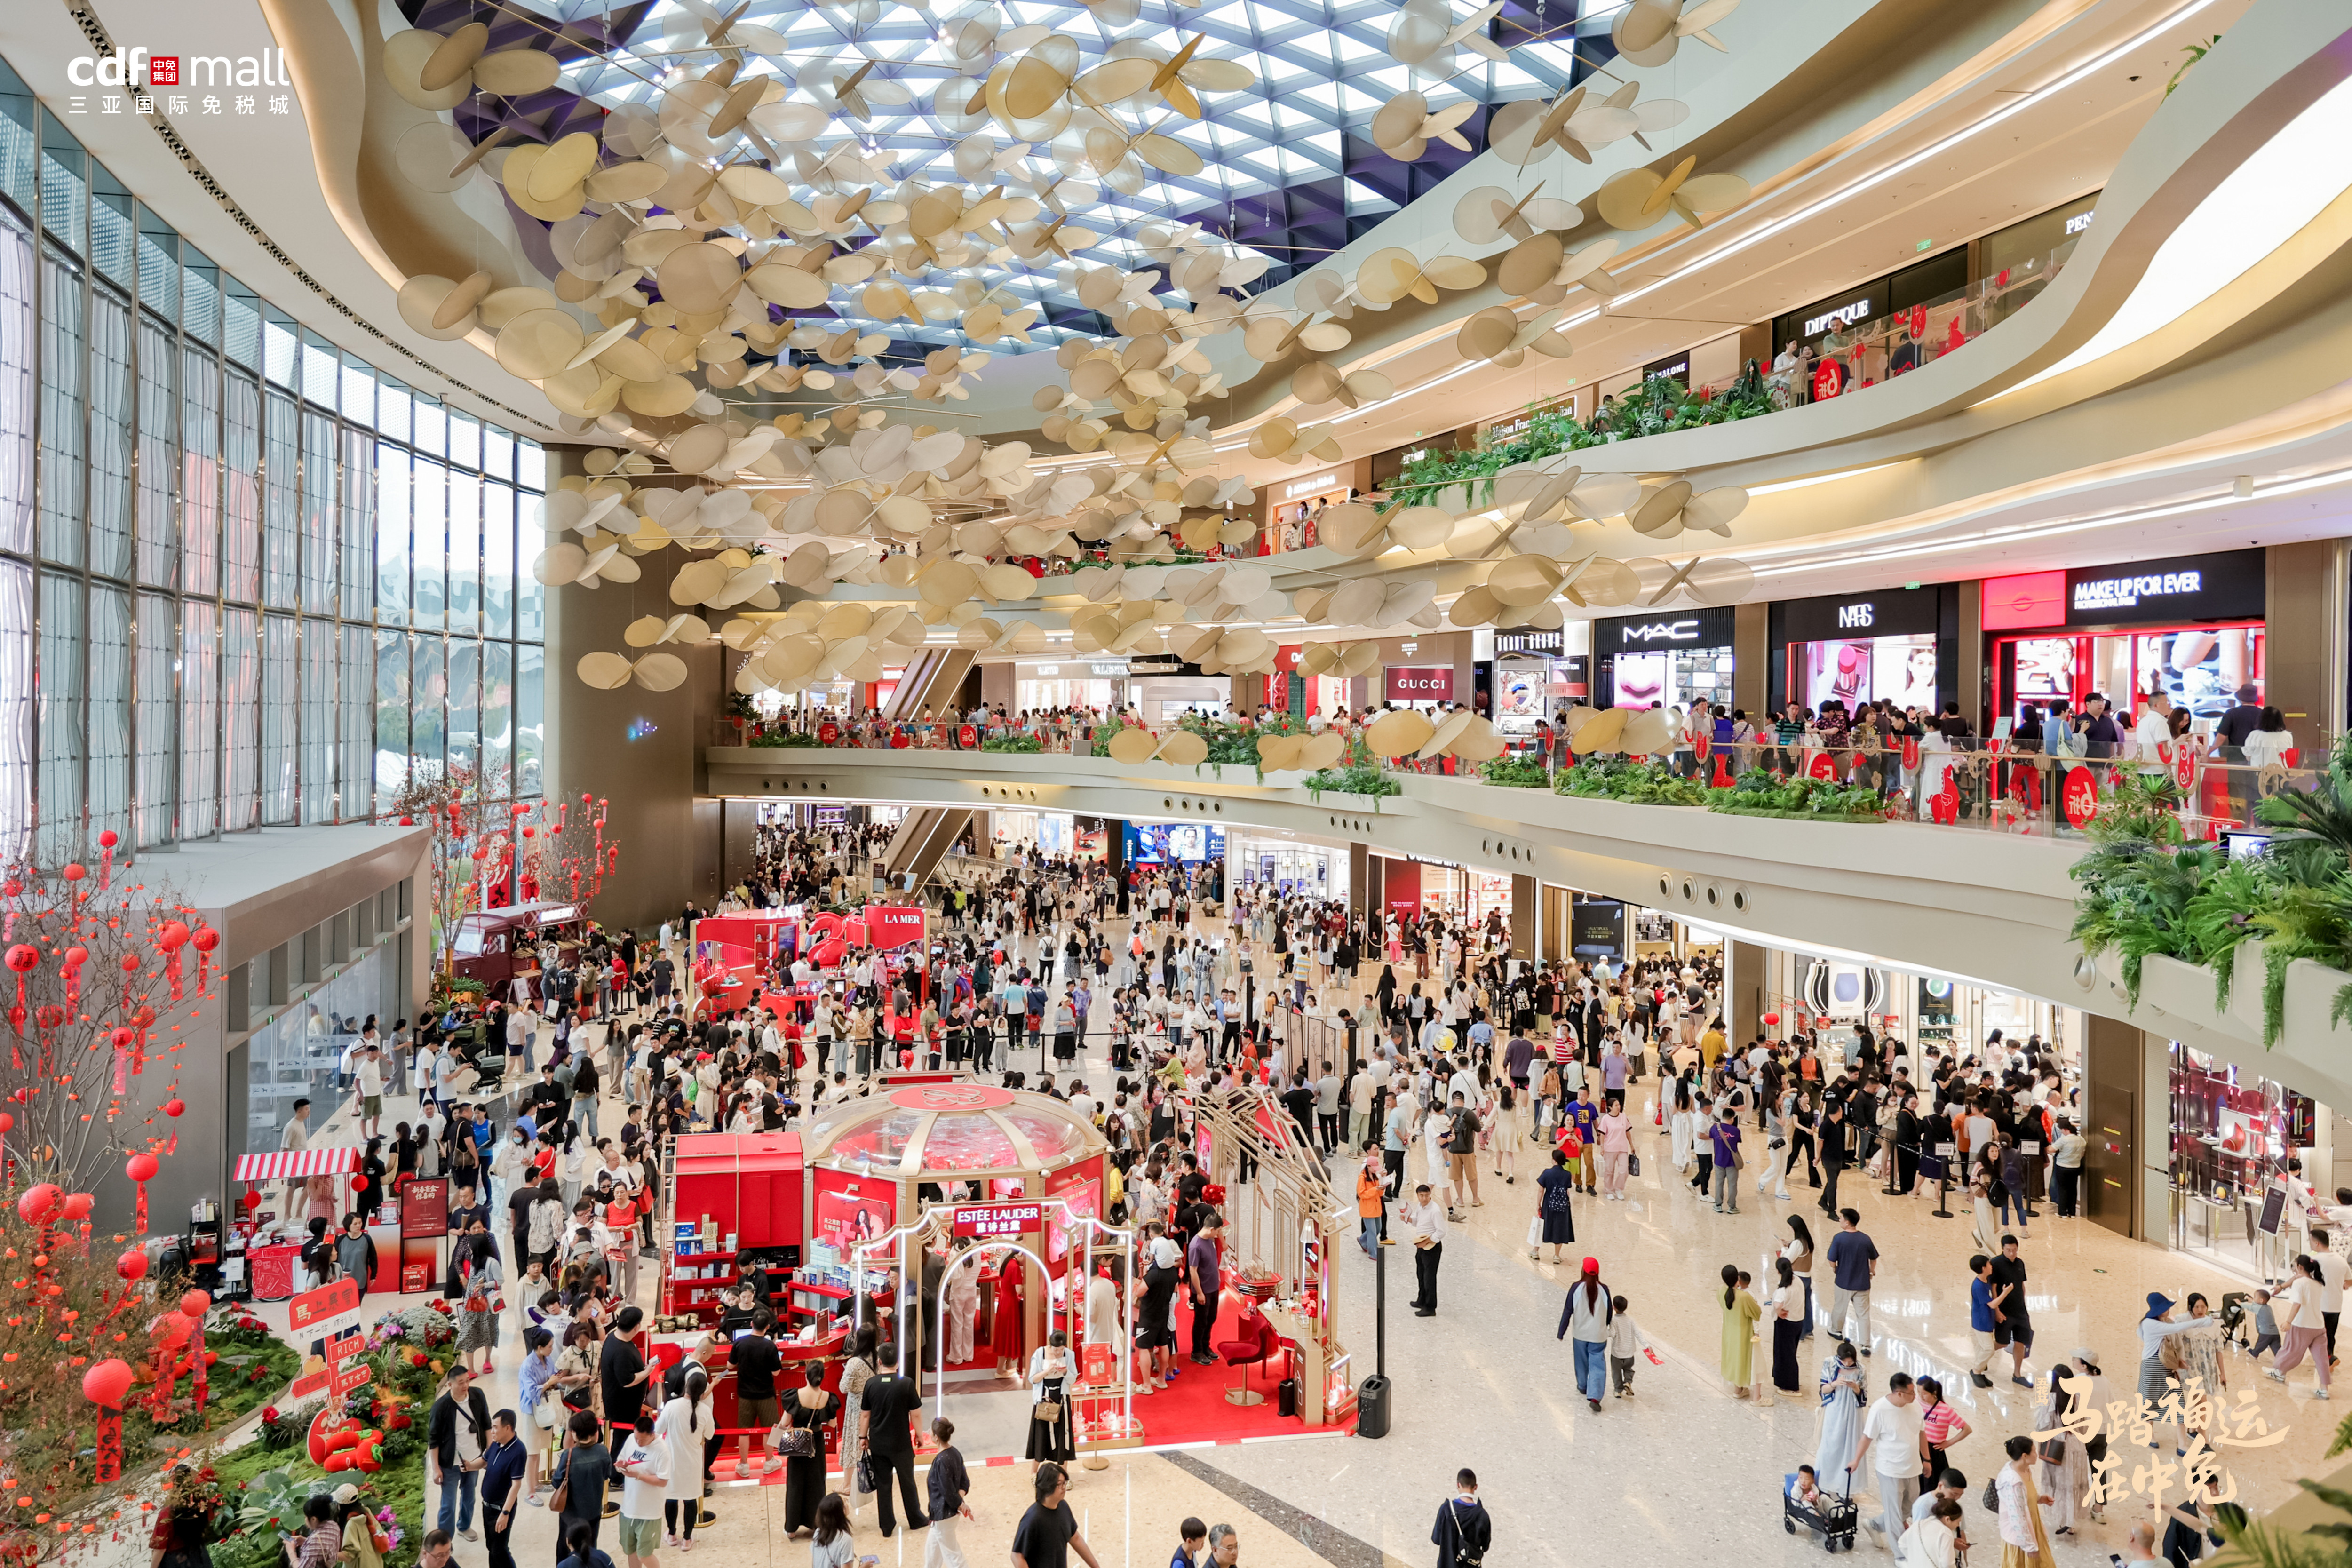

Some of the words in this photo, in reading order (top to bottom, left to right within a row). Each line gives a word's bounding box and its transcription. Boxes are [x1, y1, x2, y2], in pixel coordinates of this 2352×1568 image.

[1515, 417, 1538, 431] Fran
[2074, 581, 2114, 601] MAKE
[2114, 579, 2132, 598] UP
[2134, 576, 2162, 596] FOR
[2164, 572, 2200, 594] EVER
[1839, 604, 1872, 628] NARS
[1498, 635, 1524, 652] BOBBI
[1529, 632, 1560, 649] BROWN
[1091, 664, 1131, 675] VALENTIN
[1398, 678, 1445, 690] GUCCI
[766, 906, 784, 919] LA
[885, 914, 899, 924] LA
[900, 915, 920, 924] MER
[993, 1207, 1038, 1221] LAUDER
[976, 1220, 1020, 1233] 雅诗兰黛
[337, 1339, 359, 1356] RICH
[631, 1450, 647, 1462] NIKE
